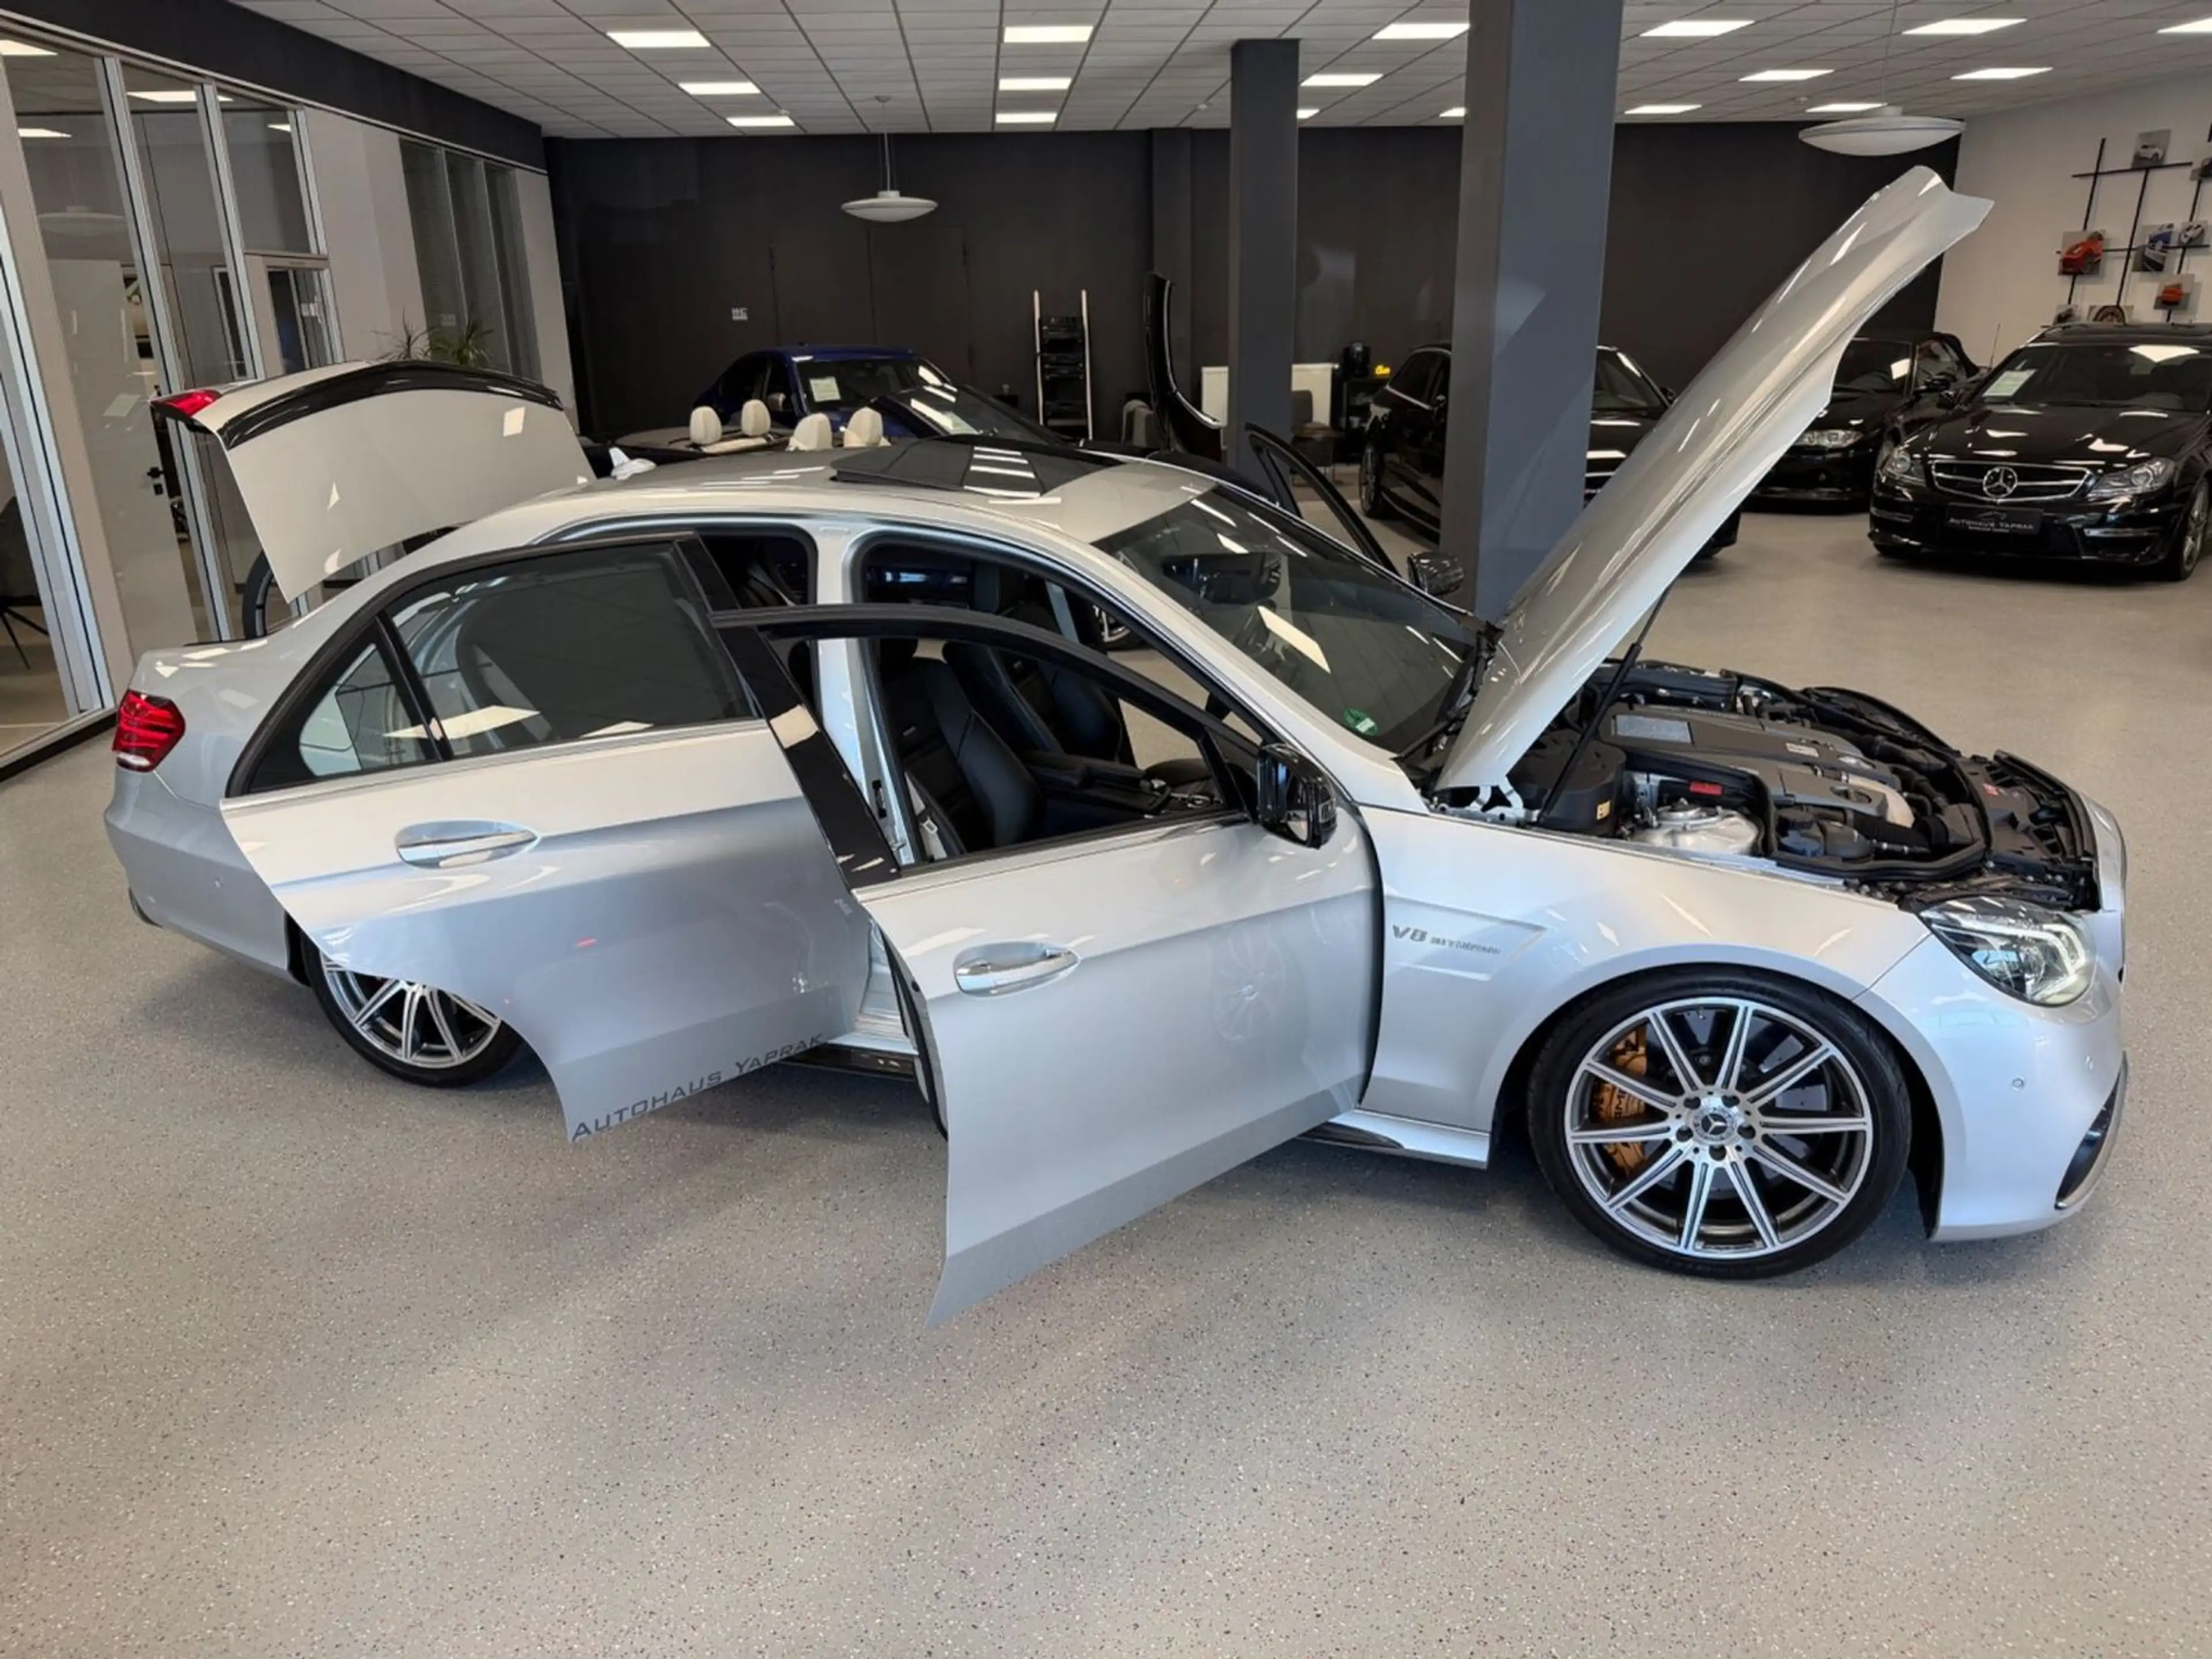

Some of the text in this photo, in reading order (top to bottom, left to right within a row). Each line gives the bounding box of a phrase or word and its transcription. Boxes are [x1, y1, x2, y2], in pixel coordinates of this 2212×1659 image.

[1392, 924, 1427, 942] V8
[571, 1032, 823, 1142] AUTOHAUS YAPRAK
